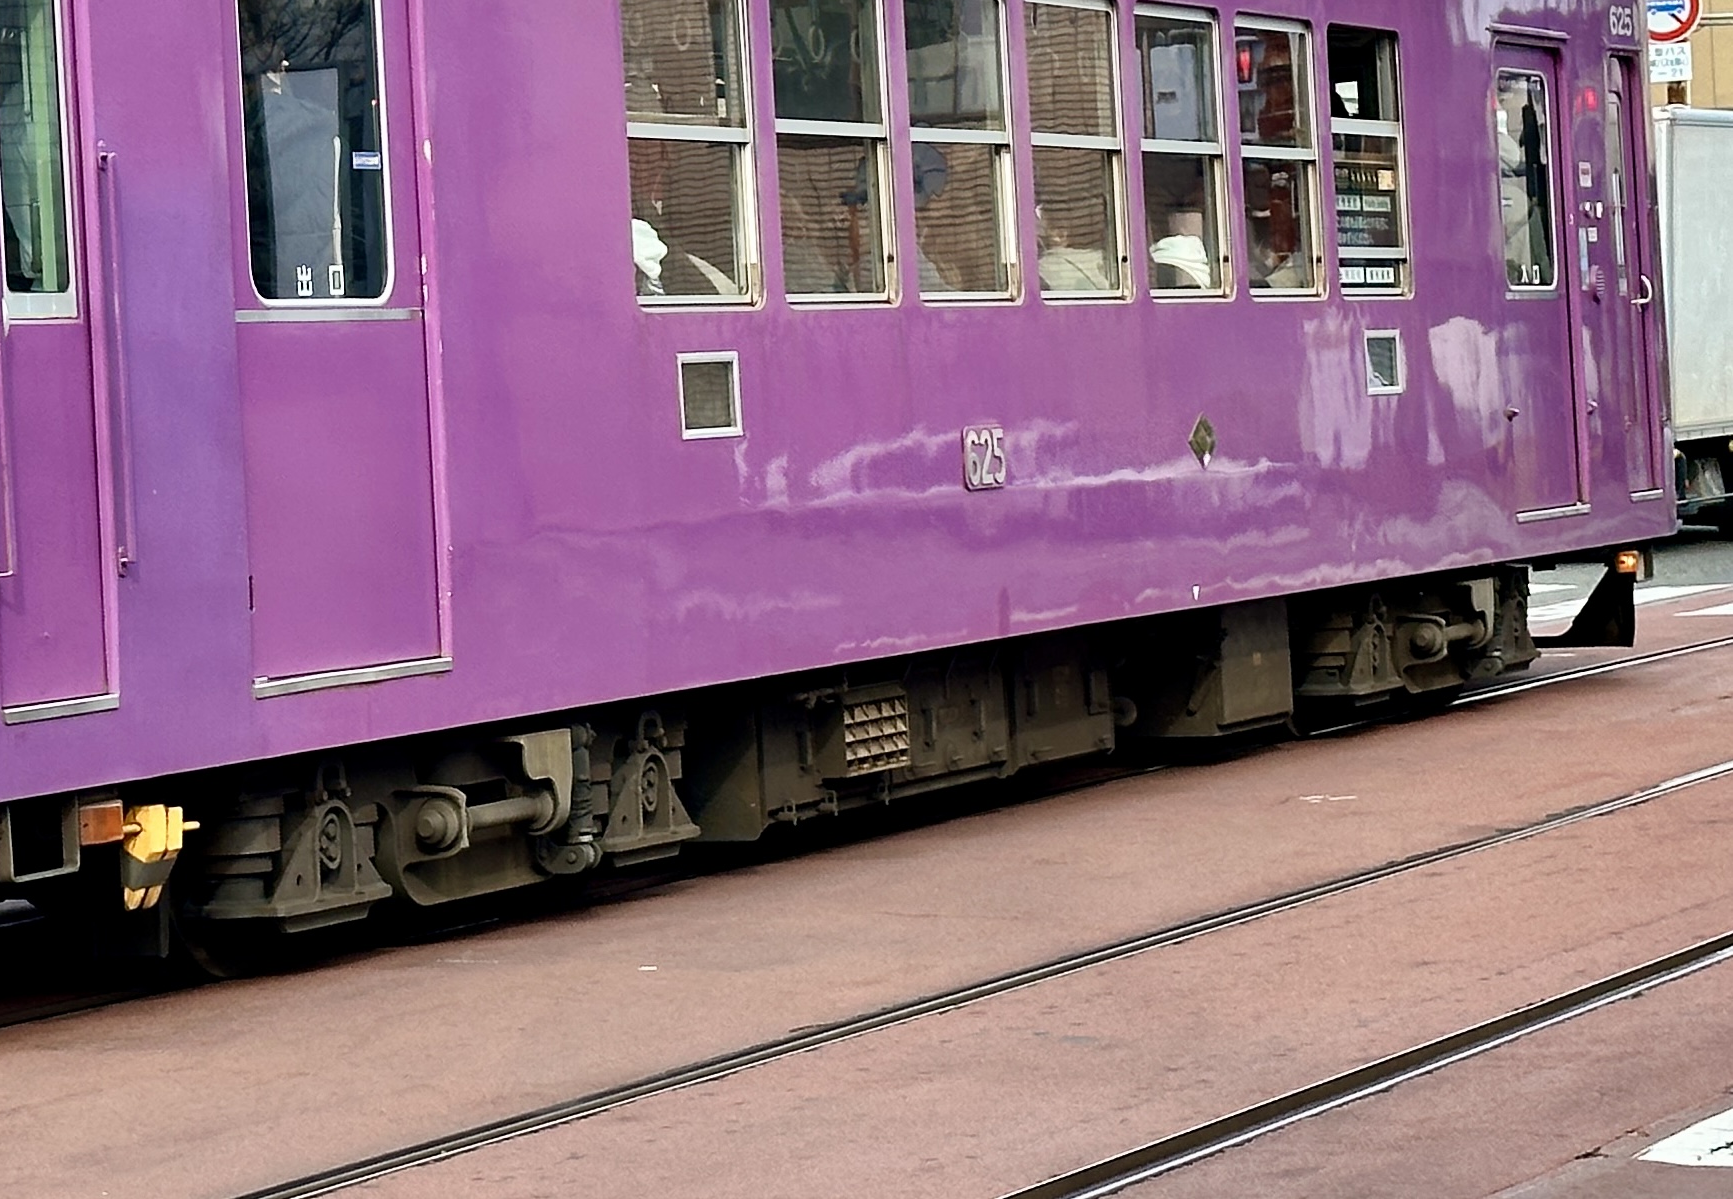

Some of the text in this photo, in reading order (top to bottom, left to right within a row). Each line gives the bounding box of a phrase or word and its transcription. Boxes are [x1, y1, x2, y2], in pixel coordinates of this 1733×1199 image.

[1609, 5, 1633, 36] 625
[296, 264, 345, 297] 出口
[1520, 264, 1540, 285] 入口
[966, 428, 1006, 486] 625
